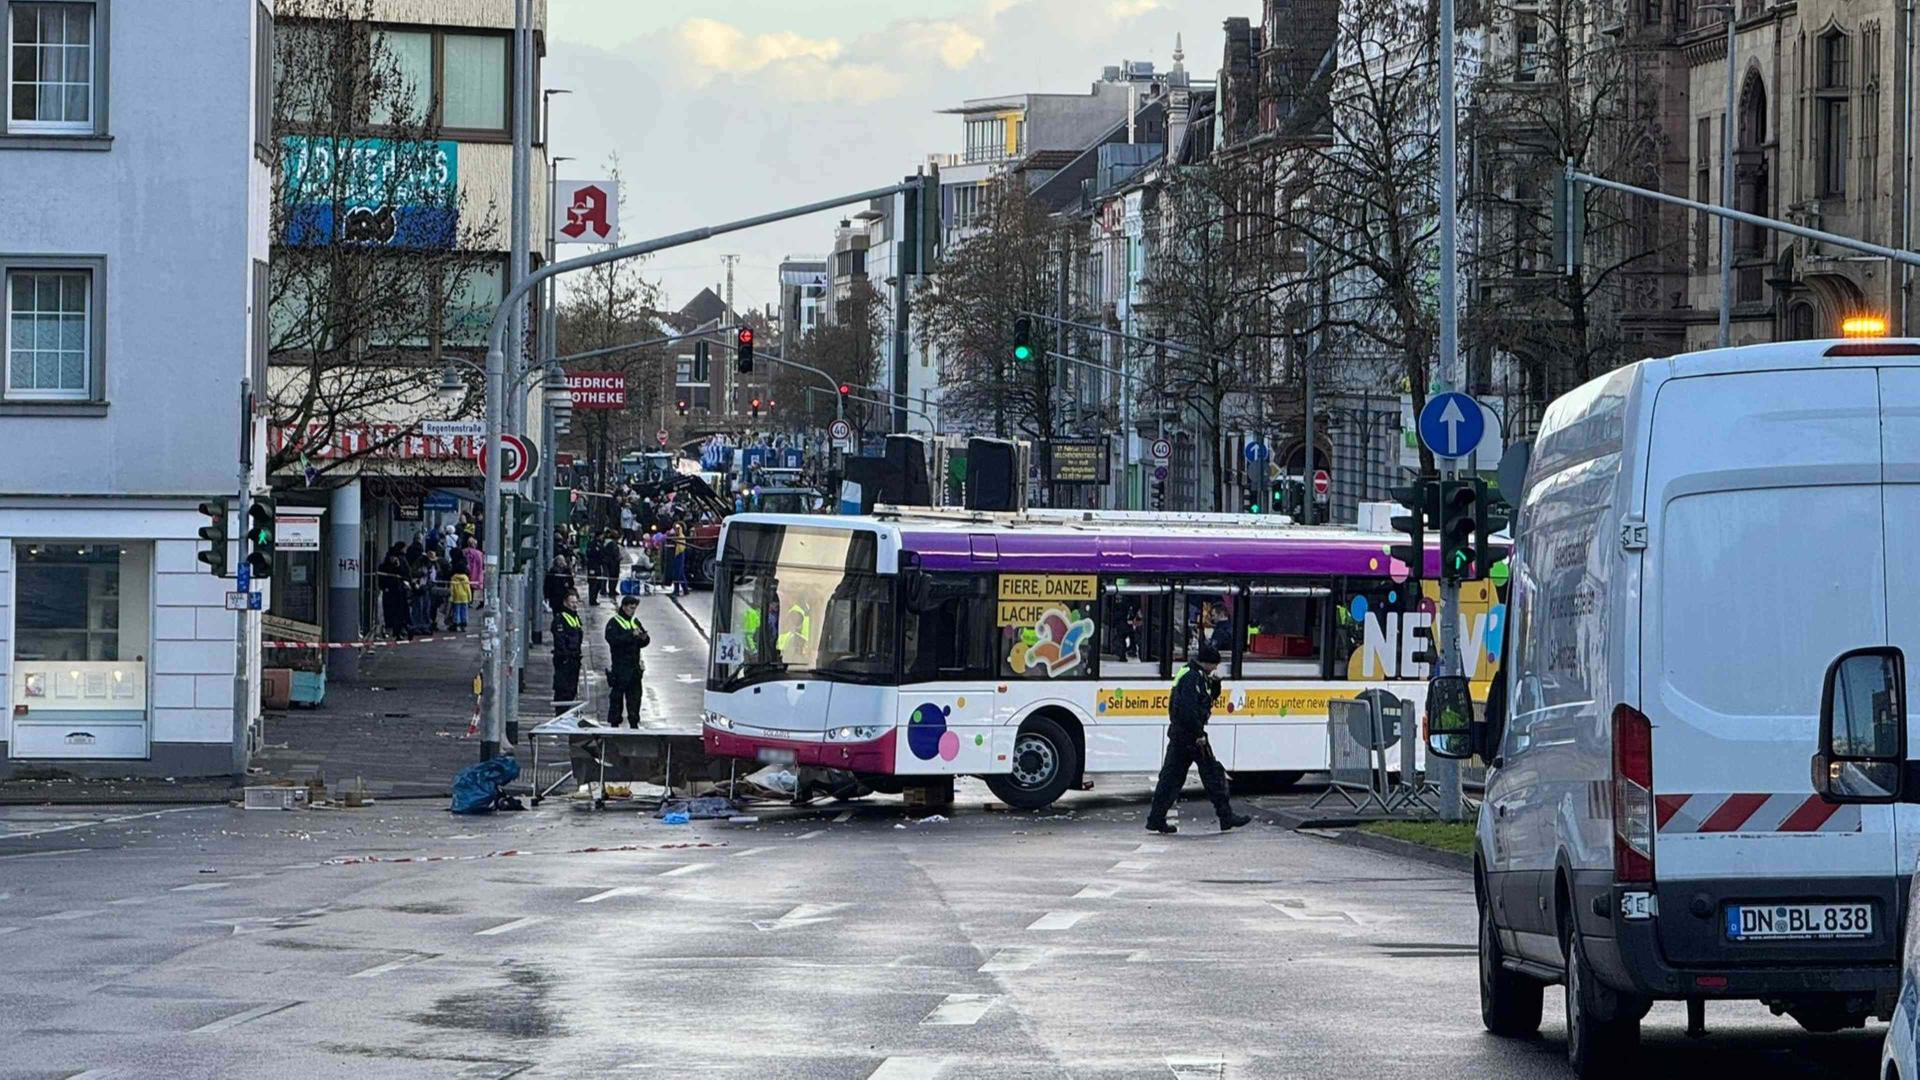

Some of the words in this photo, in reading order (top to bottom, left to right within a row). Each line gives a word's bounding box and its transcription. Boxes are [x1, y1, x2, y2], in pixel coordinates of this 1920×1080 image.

[572, 391, 624, 403] OTHEKE
[426, 423, 482, 435] Regentenstraße
[834, 425, 846, 435] 40
[1156, 444, 1168, 454] 40
[1003, 579, 1042, 597] FIERE,
[1045, 579, 1092, 598] DANZE,
[1002, 606, 1044, 622] LACHE
[1362, 611, 1488, 678] NEW
[1108, 696, 1123, 709] Sei
[1125, 697, 1149, 709] beim
[1151, 696, 1168, 710] JEC
[1257, 696, 1279, 709] Infos
[1281, 698, 1304, 709] unter
[1742, 909, 1773, 932] DN
[1789, 909, 1820, 932] BL
[1824, 908, 1868, 931] 838
